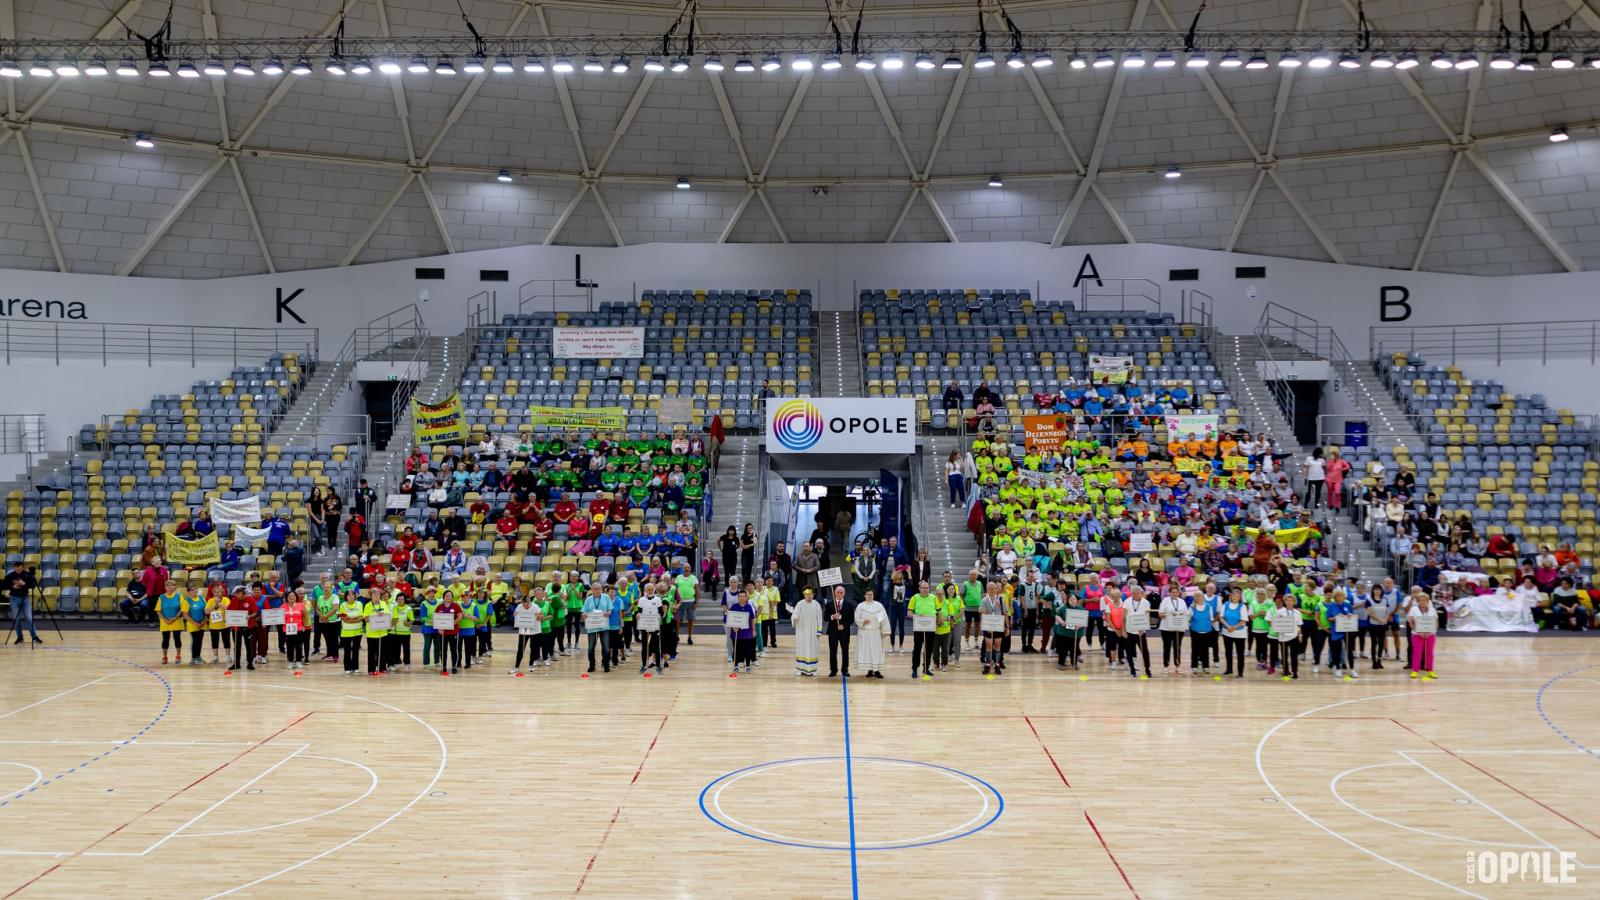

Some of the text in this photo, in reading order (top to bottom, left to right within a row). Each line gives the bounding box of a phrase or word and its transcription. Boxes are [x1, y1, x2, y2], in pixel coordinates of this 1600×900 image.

[576, 254, 598, 288] L
[1073, 253, 1104, 288] A
[276, 287, 307, 324] K
[1380, 286, 1412, 322] B
[436, 432, 460, 440] MECIE
[830, 417, 908, 434] OPOLE
[212, 612, 221, 620] 15
[287, 624, 297, 633] 13
